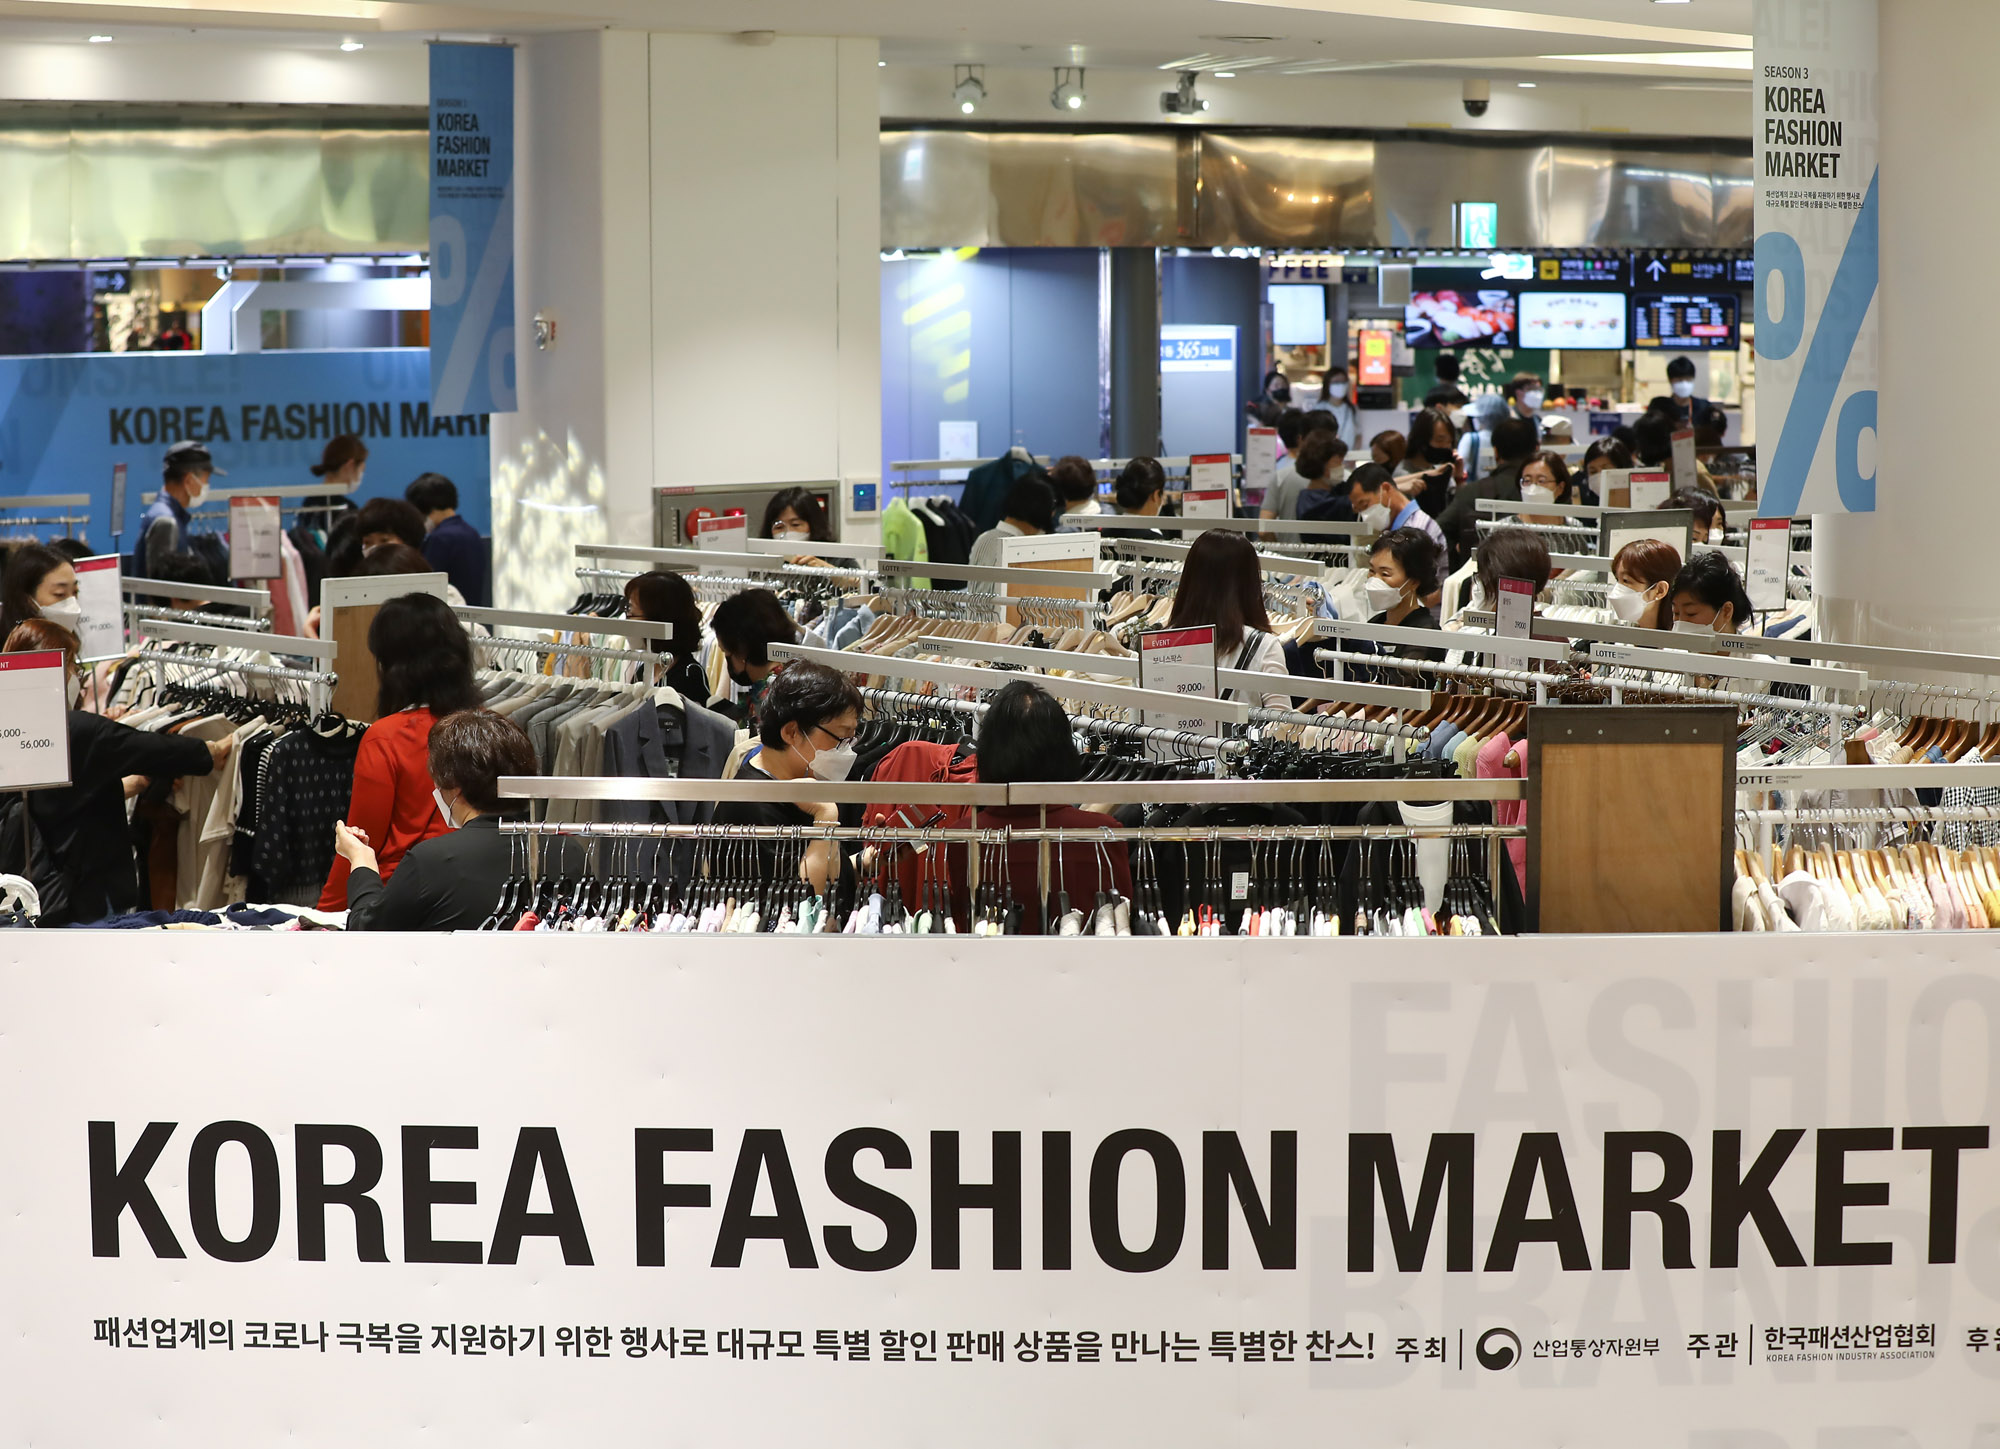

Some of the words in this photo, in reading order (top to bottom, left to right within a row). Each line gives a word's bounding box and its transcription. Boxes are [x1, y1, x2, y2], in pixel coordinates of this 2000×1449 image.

[1764, 65, 1802, 79] SEASON
[1803, 67, 1809, 80] 3
[1765, 86, 1826, 114] KOREA
[436, 113, 479, 131] KOREA
[1765, 119, 1842, 147] FASHION
[436, 136, 491, 155] FASHION
[436, 159, 489, 177] MARKET
[1765, 151, 1841, 179] MARKET
[109, 406, 230, 444] KOREA
[241, 402, 391, 440] FASHION
[1120, 544, 1137, 552] LOTTE
[882, 564, 900, 572] LOTTE
[1468, 616, 1488, 624] LOTTE
[142, 626, 158, 634] LOTTE
[1317, 625, 1338, 633] LOTTE
[922, 643, 941, 651] LOTTE
[1152, 639, 1170, 647] EVENT
[1721, 640, 1744, 649] LOTTE
[772, 650, 790, 658] LOTTE
[1152, 654, 1183, 665] 보니스팍스
[1595, 650, 1616, 659] LOTTE
[88, 1121, 594, 1266] KOREA
[635, 1127, 1298, 1273] FASHION
[1347, 1126, 1990, 1273] MARKET
[94, 1317, 233, 1350] 패션업계의
[244, 1322, 328, 1352] 코로나
[337, 1324, 422, 1353] 극복을
[432, 1324, 544, 1356] 지원하기
[555, 1326, 612, 1357] 위한
[621, 1327, 708, 1358] 행사로
[718, 1329, 804, 1360] 대규모
[813, 1330, 870, 1361] 특별
[880, 1330, 936, 1361] 할인
[947, 1331, 1003, 1362] 판매
[1014, 1331, 1102, 1362] 상품을
[1112, 1331, 1199, 1362] 만나는
[1209, 1331, 1297, 1362] 특별한
[1306, 1331, 1374, 1362] 찬스!
[1765, 1323, 1935, 1351] 한국패션산업협회
[1532, 1339, 1660, 1359] 산업통상자원부
[1766, 1354, 1794, 1362] KOREA
[1796, 1353, 1834, 1362] FASHION
[1835, 1351, 1878, 1361] INDUSTRY
[1880, 1350, 1935, 1360] ASSOCIATION
